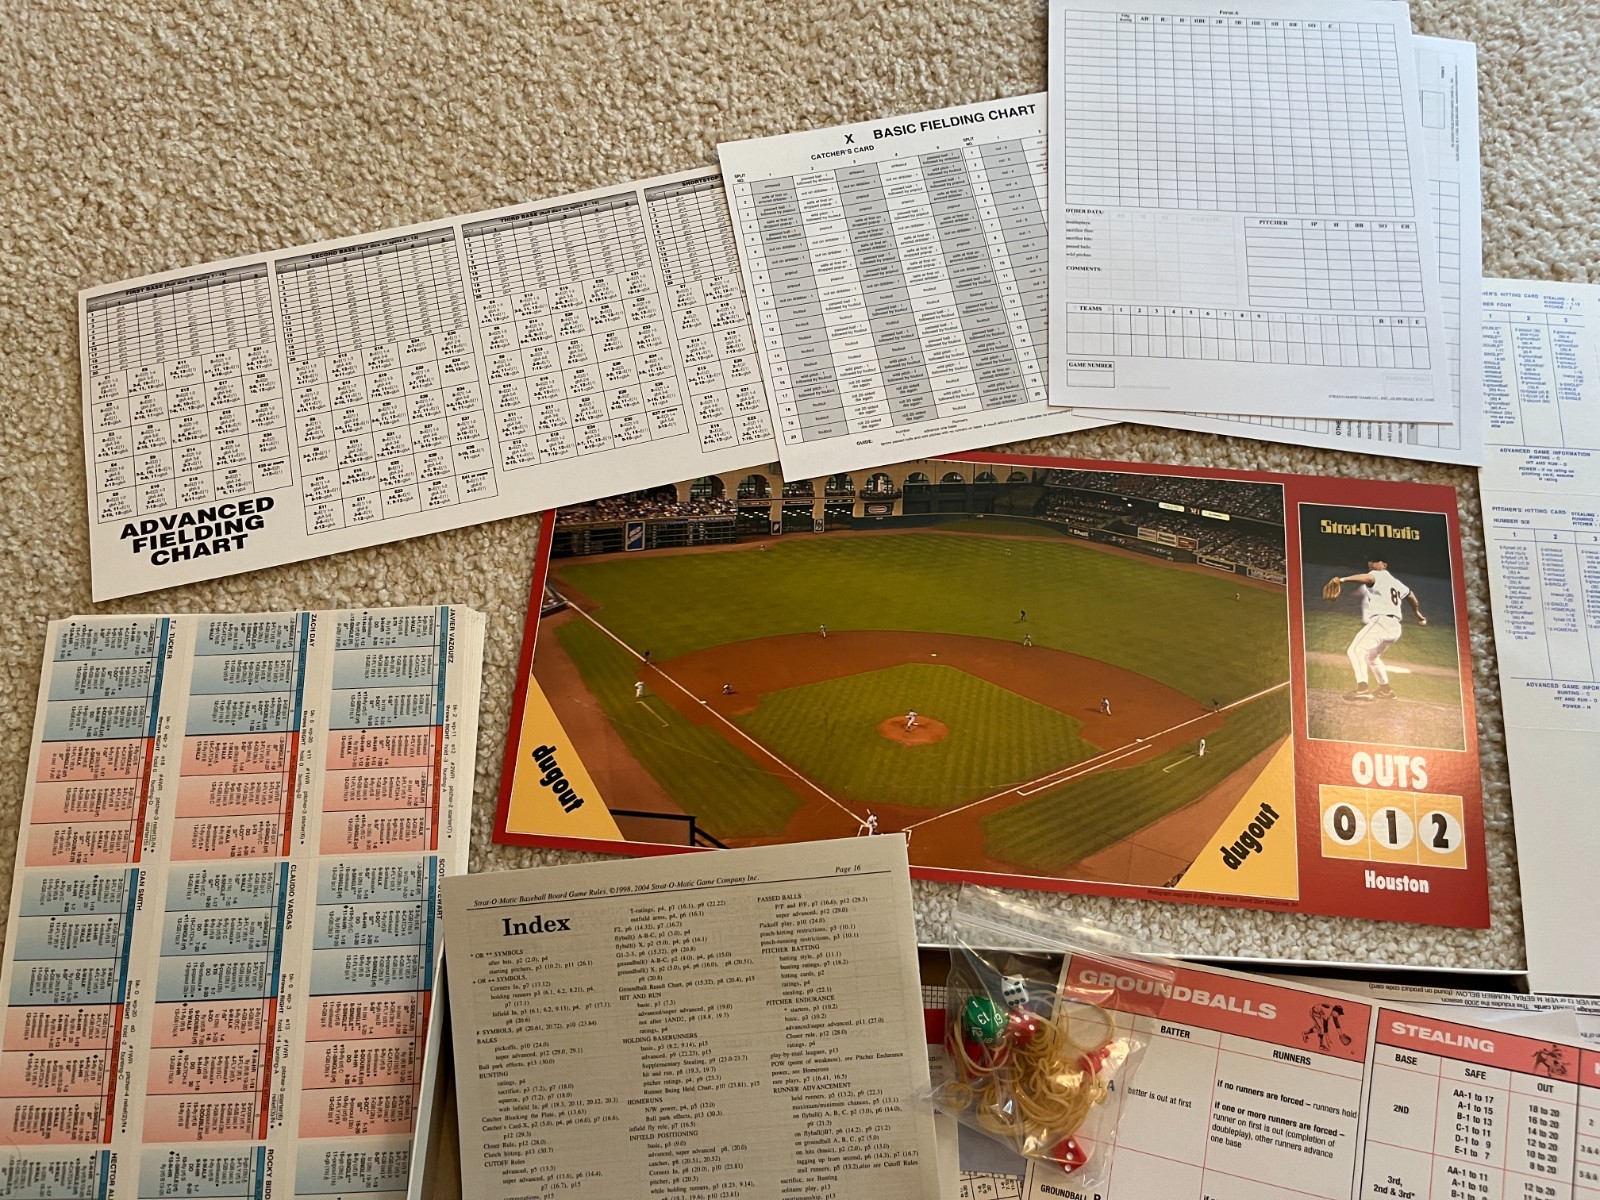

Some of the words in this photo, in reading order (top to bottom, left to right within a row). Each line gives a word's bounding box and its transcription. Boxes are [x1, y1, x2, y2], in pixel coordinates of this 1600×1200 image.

[844, 133, 854, 145] X
[873, 123, 917, 139] BASIC
[920, 112, 985, 132] FIELDING
[988, 104, 1036, 121] CHART
[810, 148, 852, 160] CATCHER'S
[853, 145, 875, 154] CARD
[311, 250, 337, 259] SECOND
[120, 496, 275, 540] ADVANCED
[132, 514, 265, 553] FIELDING
[150, 533, 248, 566] CHART
[166, 631, 175, 660] TUCKER
[447, 631, 455, 664] VAZQUEZ
[531, 745, 585, 813] dugout
[1351, 751, 1428, 790] OUTS
[1219, 802, 1280, 870] dugout
[1333, 805, 1357, 840] 0
[1386, 810, 1398, 844] 1
[1431, 813, 1449, 849] 2
[139, 869, 147, 885] DAN
[288, 864, 297, 895] CLAUDIO
[519, 893, 547, 902] Baseball
[548, 891, 568, 900] Board
[569, 890, 587, 899] Game
[634, 884, 650, 892] 2004
[651, 880, 695, 891] Strat-O-Matic
[696, 878, 715, 887] Game
[716, 876, 747, 886] Company
[747, 874, 760, 882] Inc.
[1364, 869, 1430, 893] Houston
[136, 886, 145, 911] SMITH
[285, 897, 293, 930] VARGAS
[502, 916, 571, 937] Index
[766, 998, 793, 1006] PITCHER
[795, 995, 835, 1003] ENDURANCE
[1079, 970, 1277, 1020] GROUNDBALLS
[1160, 1025, 1190, 1039] BATTER
[1391, 1021, 1495, 1053] STEALING
[1272, 1050, 1311, 1066] RUNNERS
[479, 1071, 508, 1079] BUNTING
[1395, 1053, 1417, 1066] BASE
[1464, 1068, 1486, 1080] SAFE
[1537, 1082, 1554, 1093] OUT
[773, 1086, 799, 1094] RUNNER
[802, 1082, 852, 1091] ADVANCEMENT
[1127, 1086, 1148, 1097] batter
[1149, 1091, 1155, 1099] is
[1156, 1094, 1168, 1102] out
[1178, 1098, 1192, 1108] first
[1217, 1079, 1223, 1088] if
[1224, 1081, 1234, 1090] no
[1235, 1084, 1264, 1097] runners
[1266, 1092, 1278, 1100] are
[1280, 1094, 1304, 1107] forced
[1312, 1102, 1340, 1115] runners
[1342, 1108, 1357, 1119] hold
[1453, 1089, 1472, 1097] AA-1
[1474, 1093, 1482, 1102] to
[1485, 1095, 1494, 1104] 17
[627, 1097, 663, 1105] HOMERUNS
[1393, 1104, 1410, 1114] 2ND
[1457, 1101, 1471, 1110] A-1
[1473, 1104, 1481, 1113] to
[1484, 1106, 1493, 1115] 15
[1212, 1113, 1237, 1124] runner
[1248, 1121, 1262, 1130] first
[1272, 1127, 1284, 1136] out
[1285, 1130, 1326, 1147] (completion
[1328, 1140, 1335, 1148] of
[1214, 1101, 1221, 1109] if
[1221, 1104, 1236, 1113] one
[1247, 1110, 1266, 1120] more
[1268, 1115, 1297, 1128] runners
[1299, 1123, 1311, 1131] are
[1313, 1124, 1338, 1137] forced
[1456, 1111, 1470, 1121] B-1
[1473, 1115, 1481, 1124] to
[1483, 1117, 1493, 1126] 13
[1456, 1123, 1469, 1132] C-1
[1471, 1126, 1480, 1135] to
[1482, 1129, 1491, 1137] 11
[1210, 1135, 1224, 1144] one
[1225, 1137, 1242, 1149] base
[1211, 1123, 1253, 1141] doubleplay),
[1254, 1134, 1273, 1144] other
[1274, 1140, 1302, 1152] runners
[1303, 1146, 1334, 1159] advance
[1454, 1145, 1467, 1155] E-1
[1470, 1149, 1478, 1157] to
[1484, 1151, 1490, 1160] 7
[1455, 1134, 1468, 1143] D-1
[1471, 1137, 1479, 1146] to
[1485, 1140, 1491, 1148] 9
[109, 1153, 117, 1186] HECTOR
[1387, 1175, 1403, 1188] 3rd,
[1373, 1184, 1388, 1195] 2nd
[1390, 1187, 1396, 1196] &
